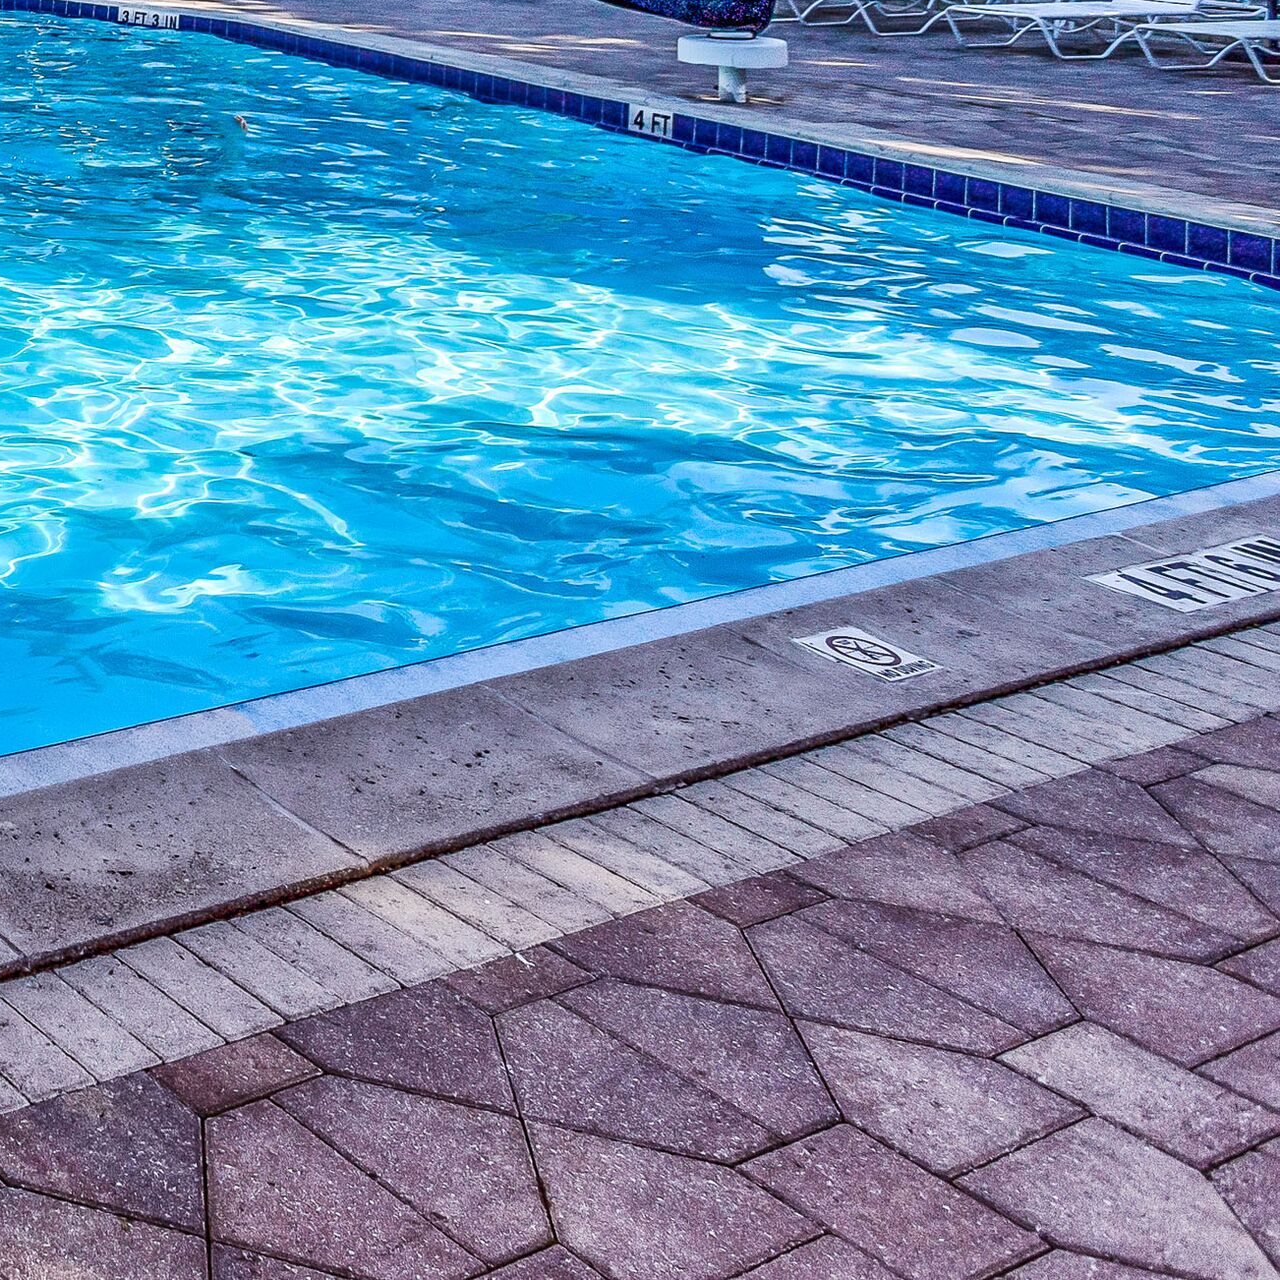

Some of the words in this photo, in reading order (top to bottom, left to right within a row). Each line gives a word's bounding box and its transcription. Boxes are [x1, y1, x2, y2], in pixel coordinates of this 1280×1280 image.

[122, 10, 130, 23] 3
[134, 11, 147, 24] FT
[152, 14, 160, 26] 3
[165, 15, 177, 29] IN
[633, 110, 644, 130] 4
[651, 112, 671, 136] FT
[1145, 561, 1258, 598] FT
[1204, 555, 1280, 582] 6
[1117, 573, 1208, 604] 4
